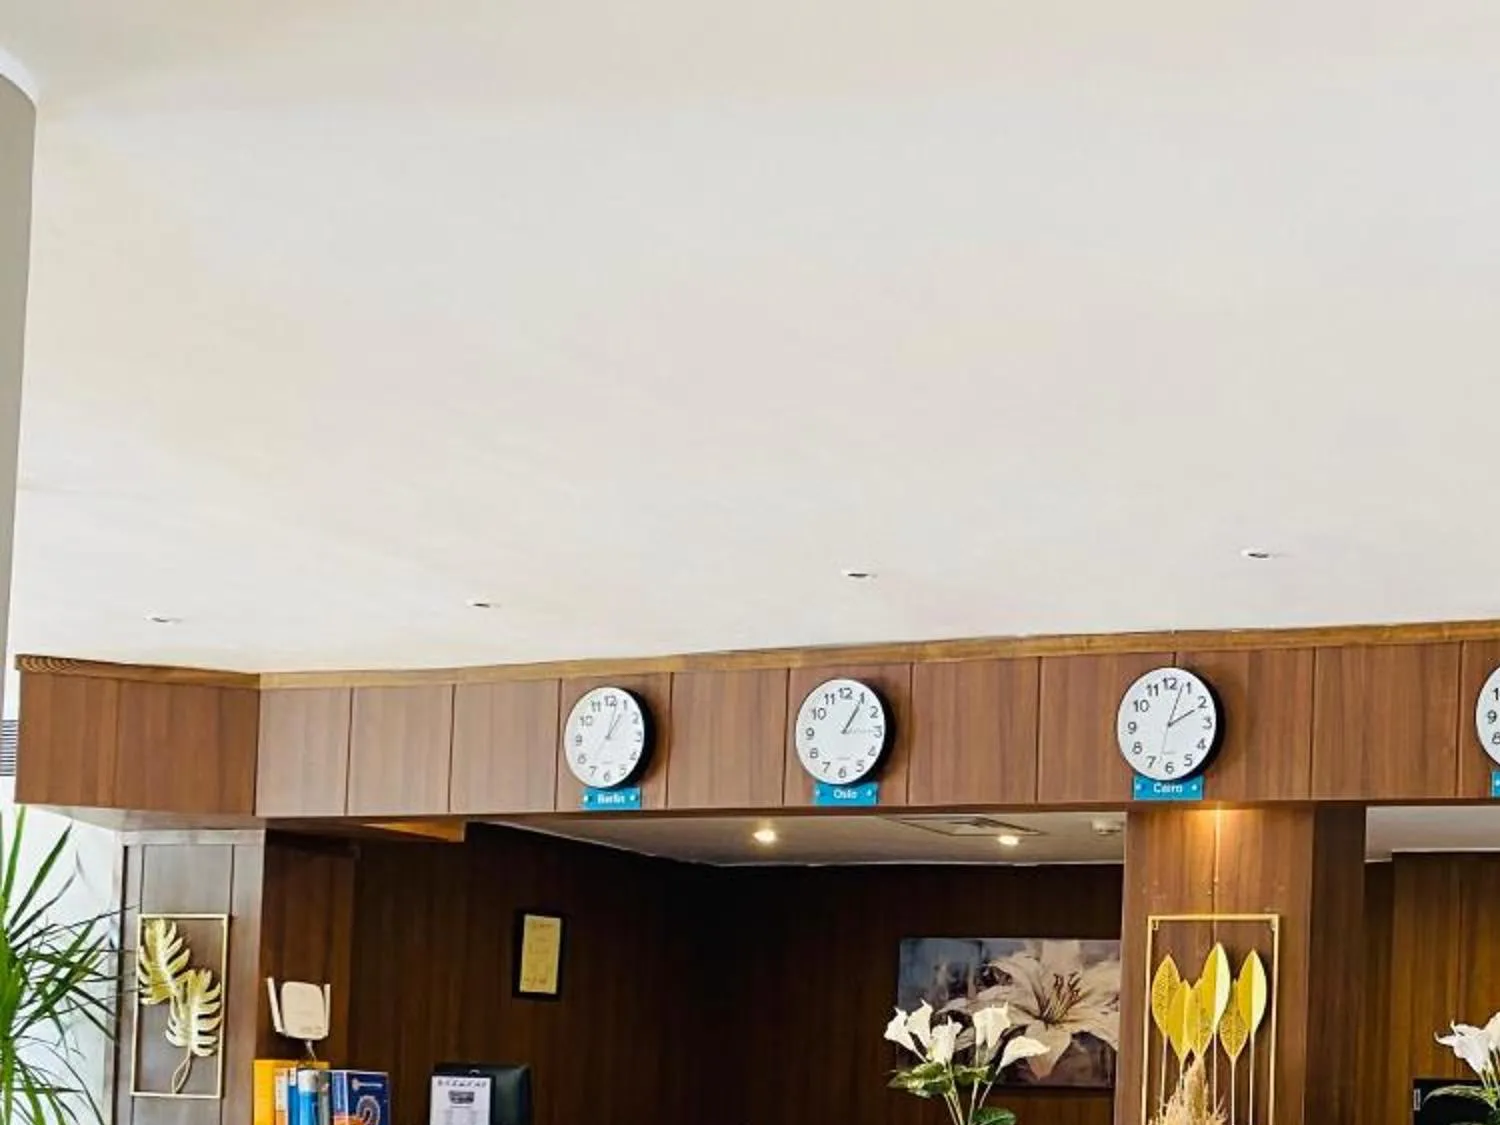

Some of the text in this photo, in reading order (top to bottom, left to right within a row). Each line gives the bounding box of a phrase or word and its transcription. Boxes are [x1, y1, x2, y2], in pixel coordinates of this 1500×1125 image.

[1163, 677, 1177, 691] 12
[1186, 681, 1191, 694] 1
[838, 687, 853, 700] 12
[1146, 684, 1159, 697] 11
[824, 693, 835, 704] 11
[860, 692, 865, 704] 1
[1198, 695, 1207, 709] 2
[1133, 699, 1150, 712] 10
[812, 708, 826, 720] 10
[870, 706, 879, 719] 2
[1487, 710, 1497, 724] 9
[1128, 721, 1137, 734] 9
[1202, 717, 1212, 729] 3
[805, 727, 815, 740] 9
[873, 725, 882, 738] 3
[1132, 741, 1142, 755] 8
[1196, 738, 1206, 750] 4
[809, 748, 819, 759] 8
[867, 746, 876, 757] 4
[856, 760, 864, 772] 5
[1146, 756, 1156, 768] 7
[1183, 754, 1193, 767] 5
[822, 761, 831, 773] 7
[838, 768, 846, 778] 6
[1165, 762, 1175, 774] 6
[833, 788, 858, 799] Oslo
[1153, 783, 1183, 794] Cairo
